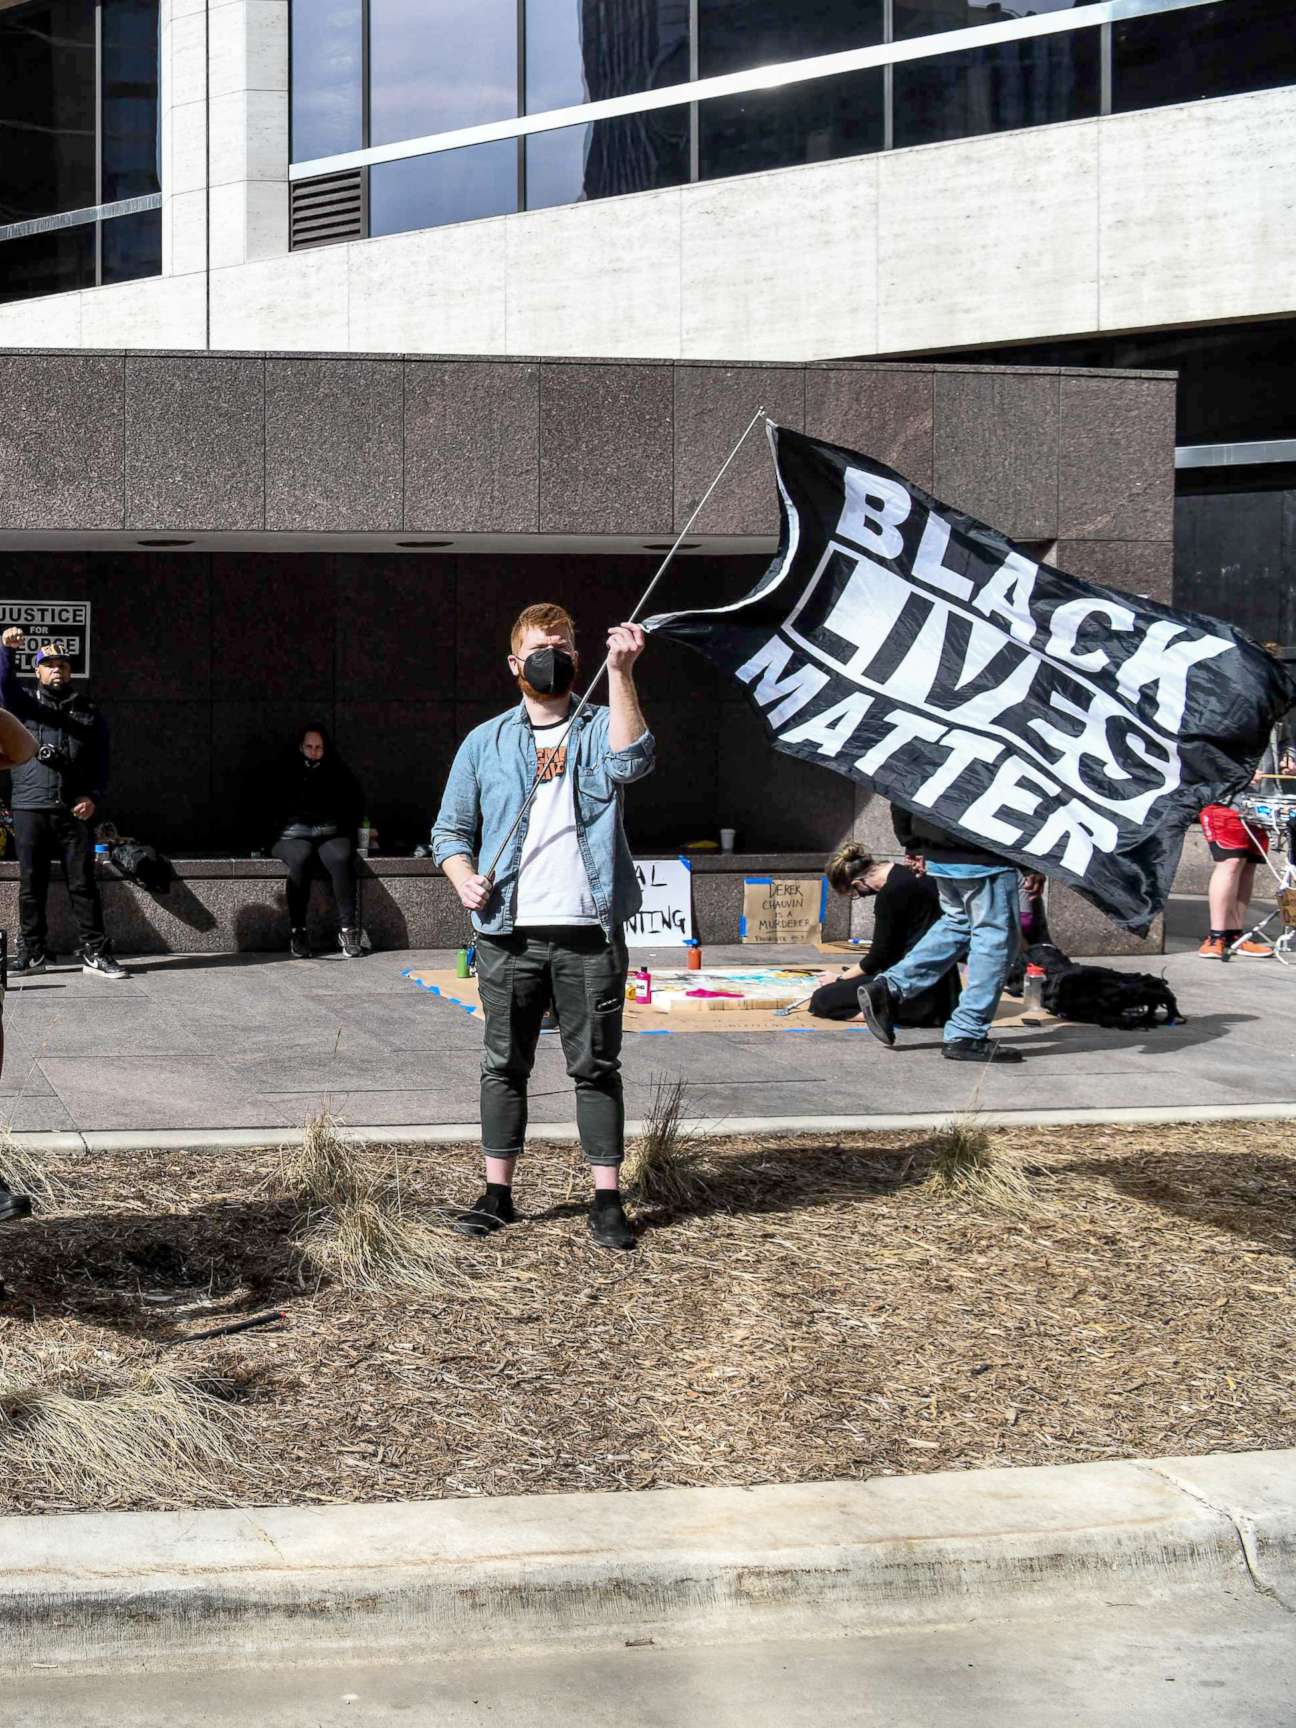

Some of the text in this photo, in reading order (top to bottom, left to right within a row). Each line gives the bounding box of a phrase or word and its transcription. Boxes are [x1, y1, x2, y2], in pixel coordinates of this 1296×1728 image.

[29, 626, 49, 634] FOR
[836, 467, 1236, 735] BLACK
[791, 548, 1170, 802] LIVES
[735, 635, 1118, 877] MATTER
[762, 898, 804, 911] CHAUVIN
[769, 881, 804, 898] DEREK
